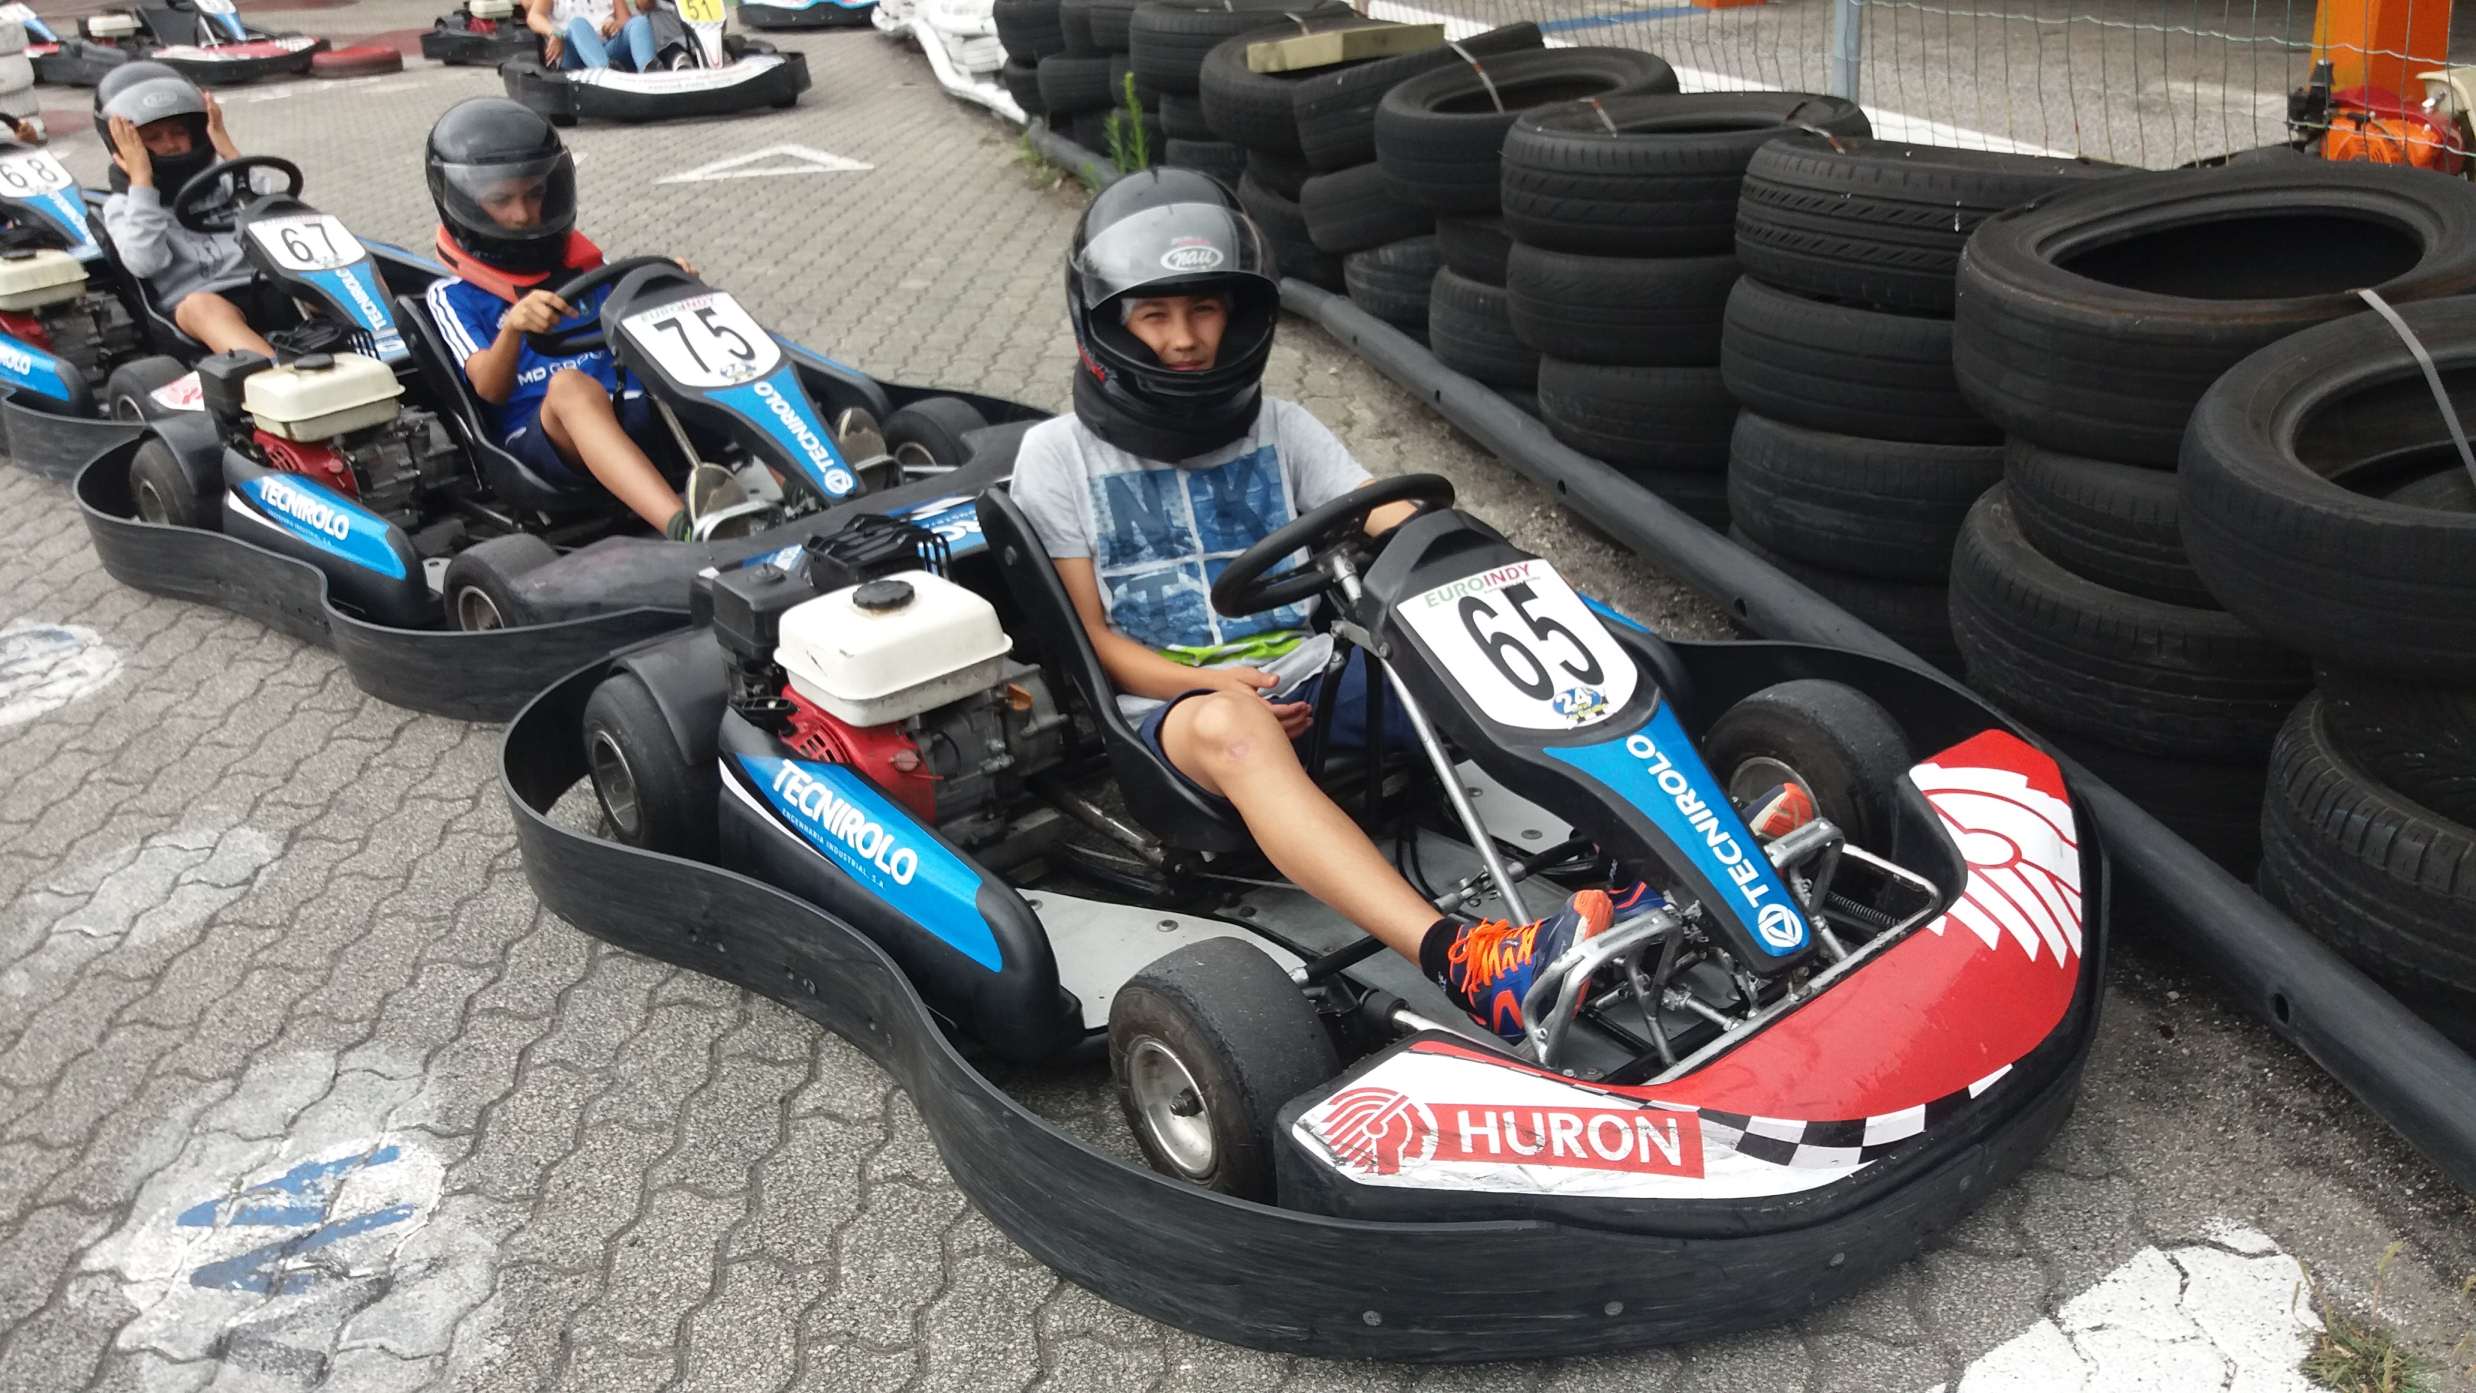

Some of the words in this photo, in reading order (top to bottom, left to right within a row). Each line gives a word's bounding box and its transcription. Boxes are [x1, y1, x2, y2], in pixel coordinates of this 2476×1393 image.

[0, 159, 58, 189] 68
[280, 222, 338, 263] 67
[652, 306, 756, 374] 75
[517, 366, 547, 387] MD
[753, 381, 835, 473] TECNIROLO
[260, 475, 349, 541] TECNIROLO
[1424, 563, 1530, 608] EUROINDY
[1457, 581, 1605, 701] 65
[772, 758, 918, 886] TECNIROLO
[1625, 733, 1771, 907] TECNIROLO
[1457, 1109, 1682, 1167] HURON
